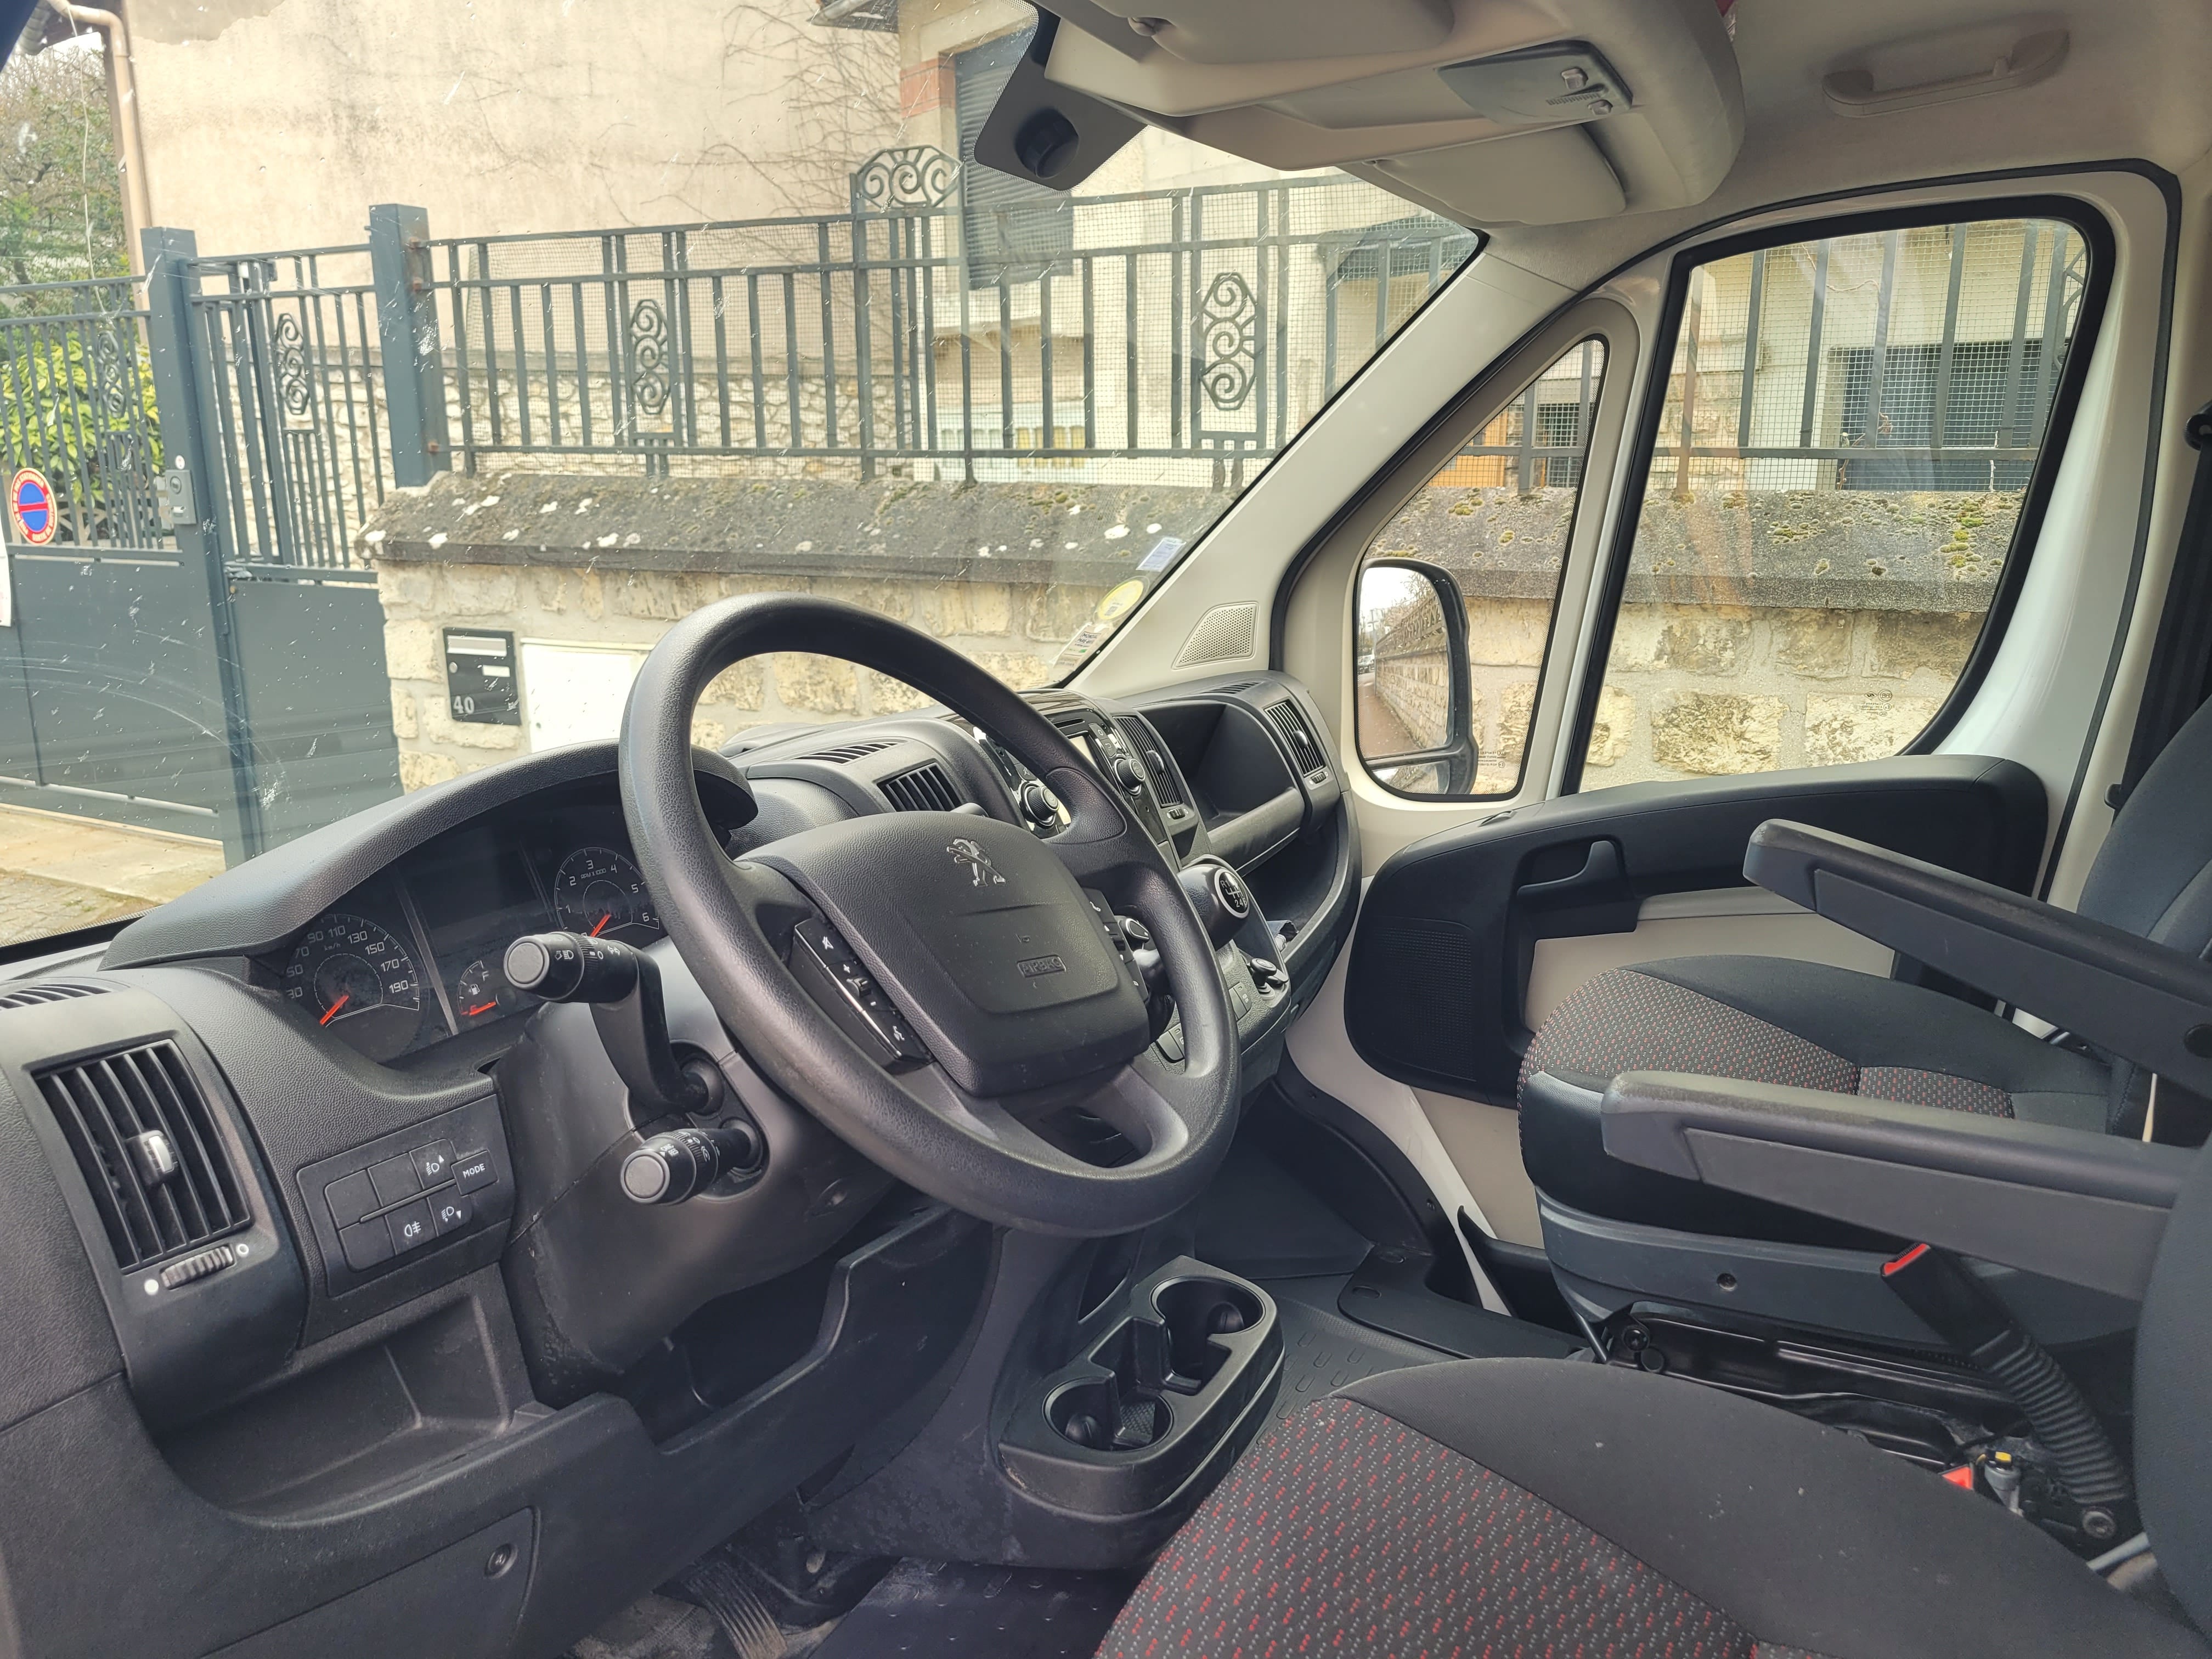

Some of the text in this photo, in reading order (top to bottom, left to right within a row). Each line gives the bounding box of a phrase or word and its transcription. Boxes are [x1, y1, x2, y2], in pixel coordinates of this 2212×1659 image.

[453, 695, 475, 714] 40
[586, 860, 594, 870] 3
[611, 864, 618, 873] 4
[569, 876, 577, 887] 2
[631, 883, 639, 893] 5
[566, 904, 571, 913] 1
[642, 912, 650, 922] 6
[307, 930, 324, 943] 90
[328, 926, 346, 938] 110
[347, 930, 368, 944] 130
[294, 946, 309, 958] 70
[365, 941, 385, 955] 150
[286, 964, 303, 978] 50
[380, 958, 400, 972] 170
[482, 970, 490, 981] F
[286, 986, 303, 999] 30
[388, 980, 409, 994] 190
[462, 1163, 486, 1179] MODE
